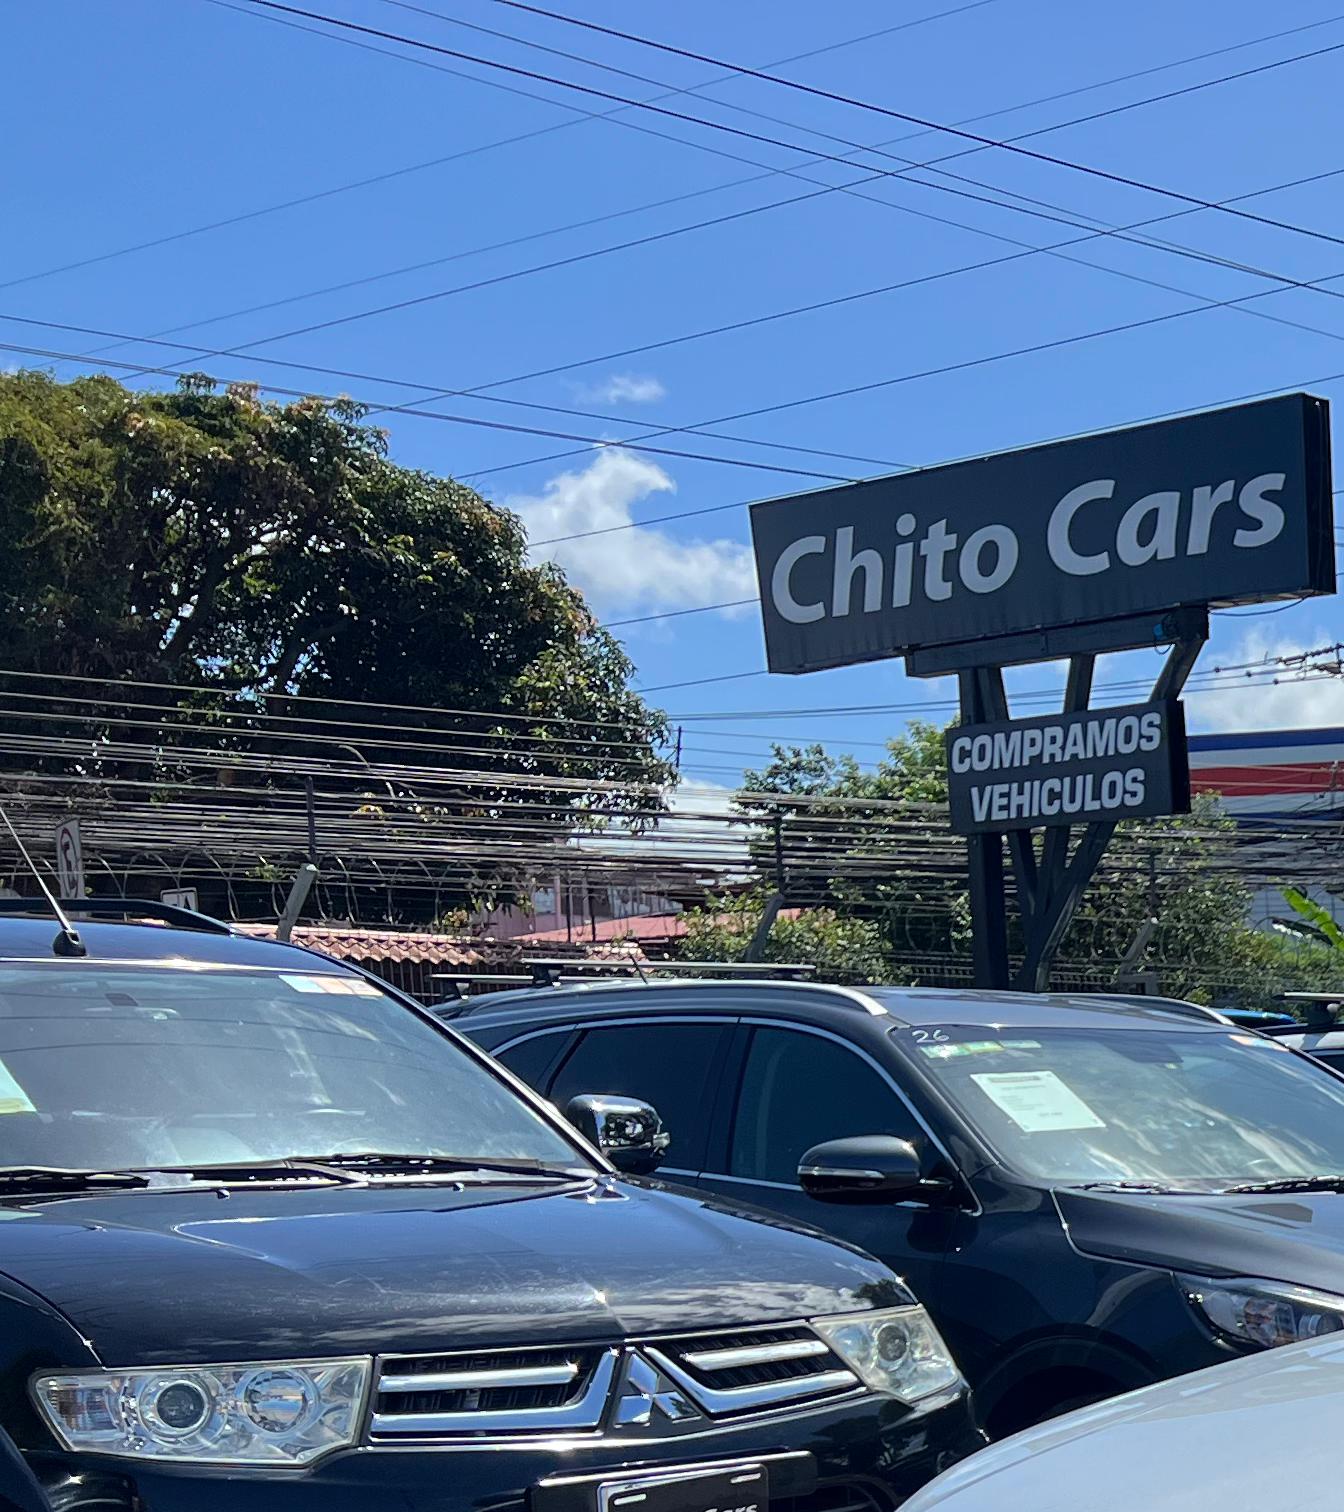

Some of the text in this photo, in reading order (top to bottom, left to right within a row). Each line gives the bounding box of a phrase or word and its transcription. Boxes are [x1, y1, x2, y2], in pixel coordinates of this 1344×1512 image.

[772, 473, 1286, 623] Chito Cars
[952, 712, 1162, 774] COMPRAMOS
[970, 768, 1145, 823] VEHICULOS
[911, 1029, 950, 1044] 26
